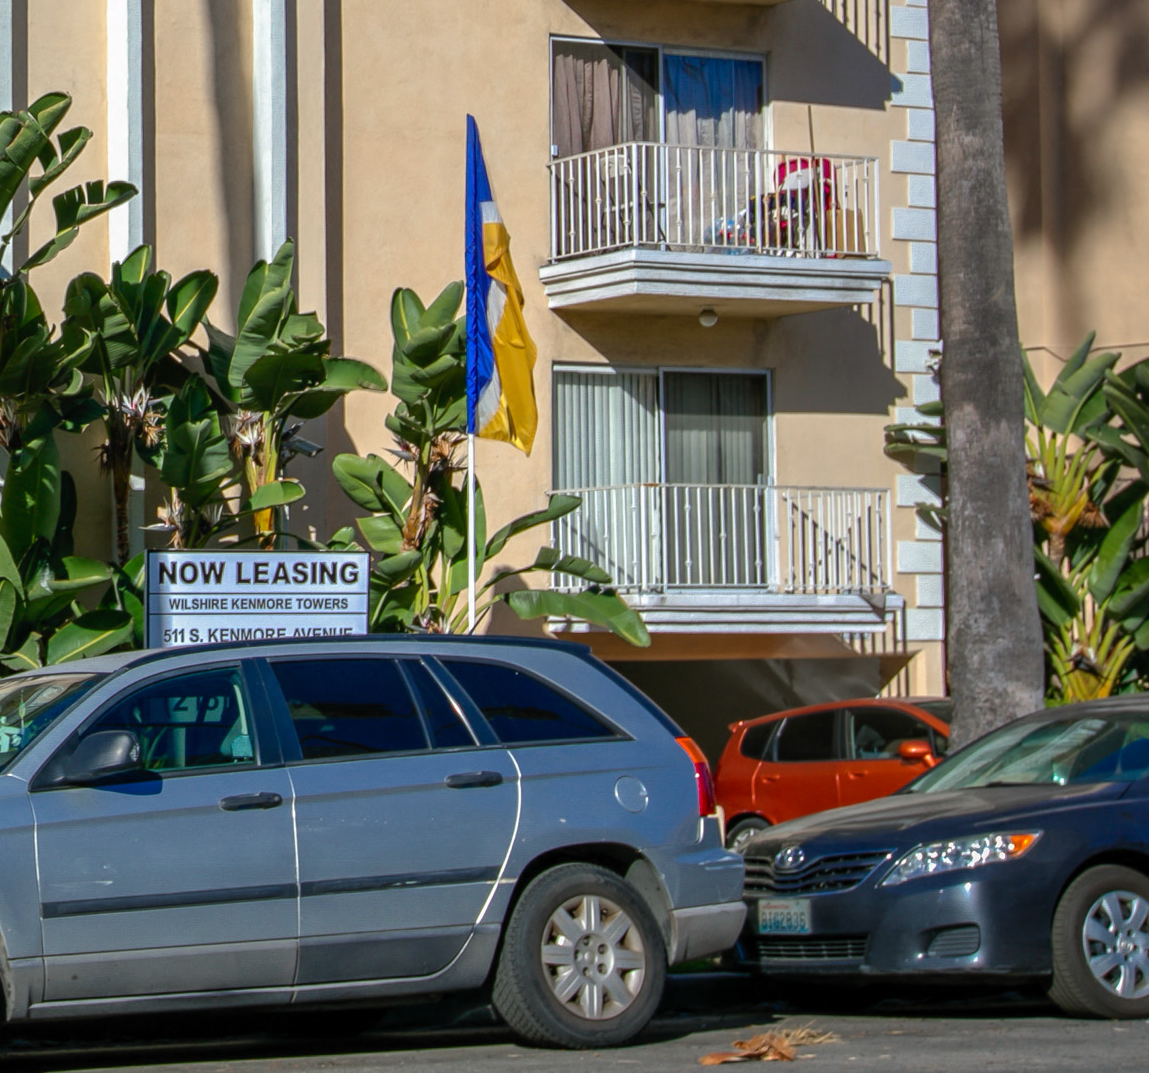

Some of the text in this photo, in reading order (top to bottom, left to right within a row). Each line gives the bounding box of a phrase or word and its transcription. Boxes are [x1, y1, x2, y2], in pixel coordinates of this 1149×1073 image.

[158, 561, 359, 585] NOW LEASING
[169, 598, 348, 610] WILSHIRE KENMORE TOWERS
[163, 628, 185, 643] 511
[189, 628, 204, 643] S.
